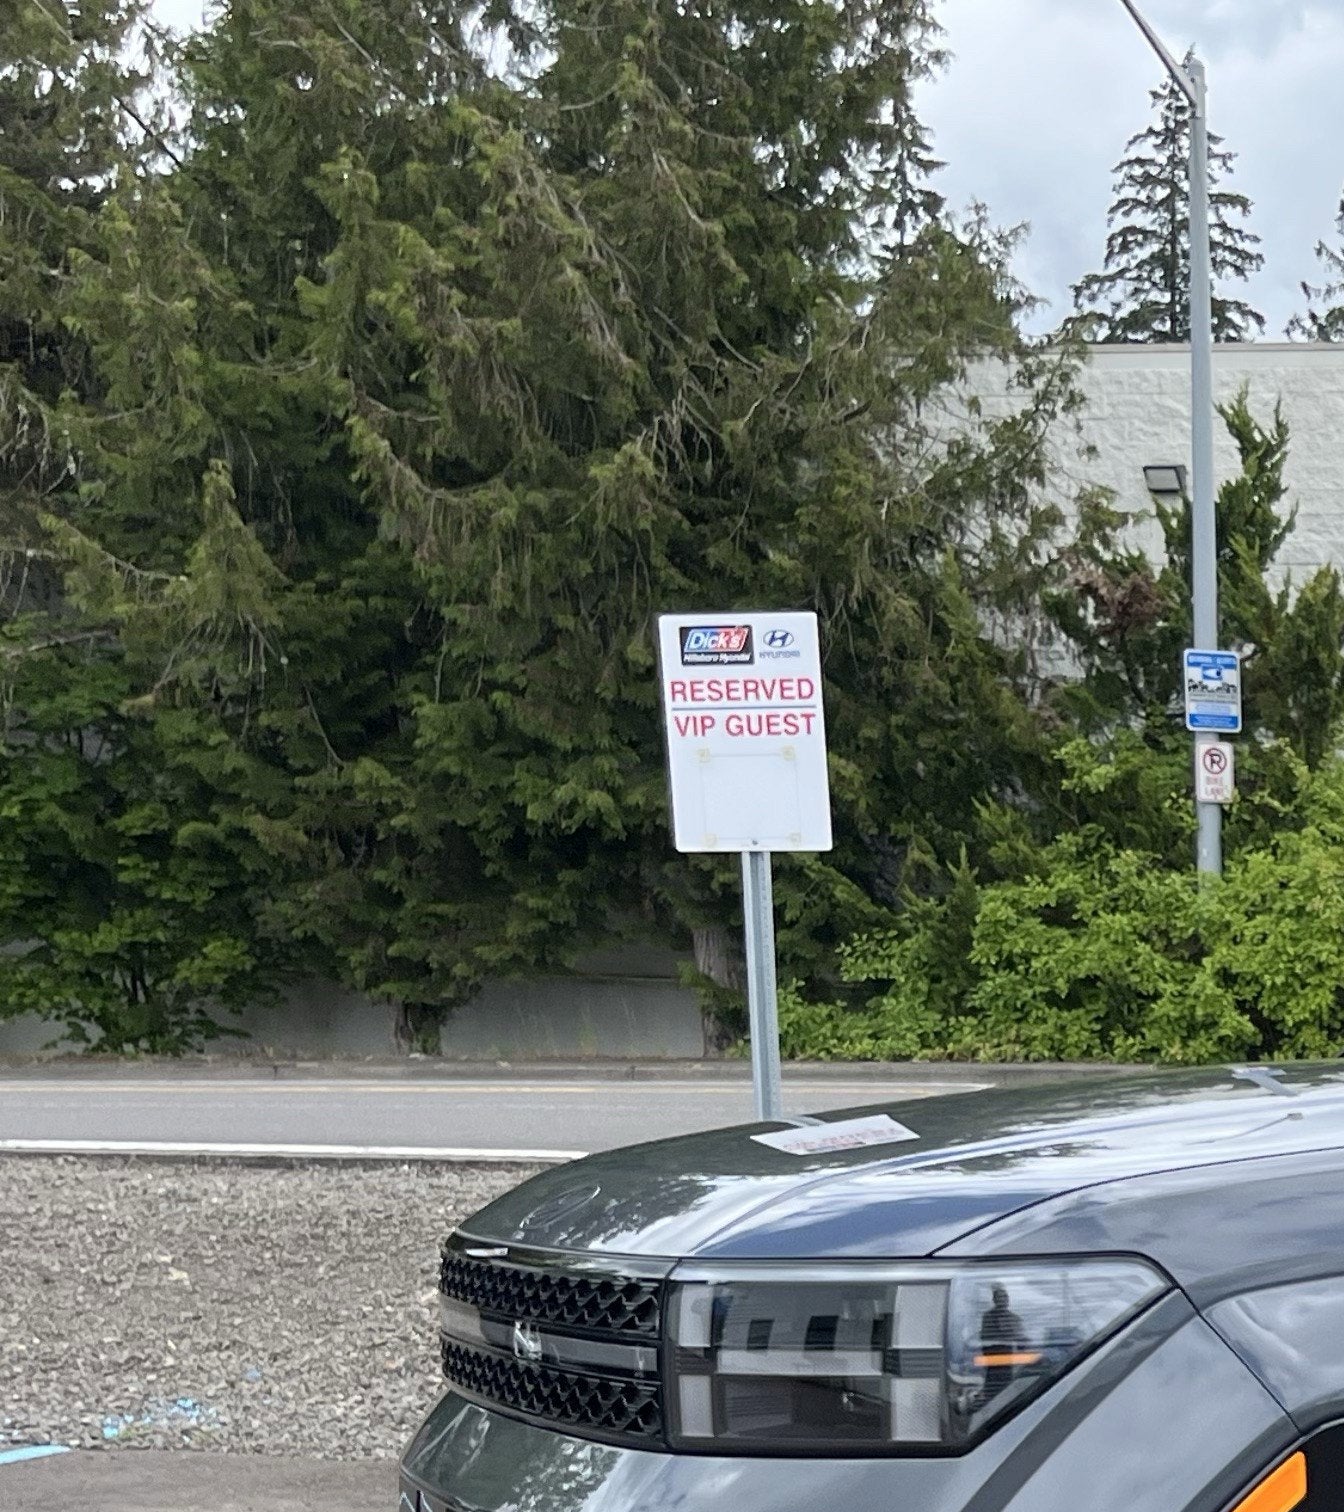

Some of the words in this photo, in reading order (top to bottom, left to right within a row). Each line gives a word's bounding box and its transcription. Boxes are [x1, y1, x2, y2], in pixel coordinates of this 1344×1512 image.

[671, 678, 815, 702] RESERVED
[674, 715, 716, 737] VIP
[725, 713, 816, 737] GUEST
